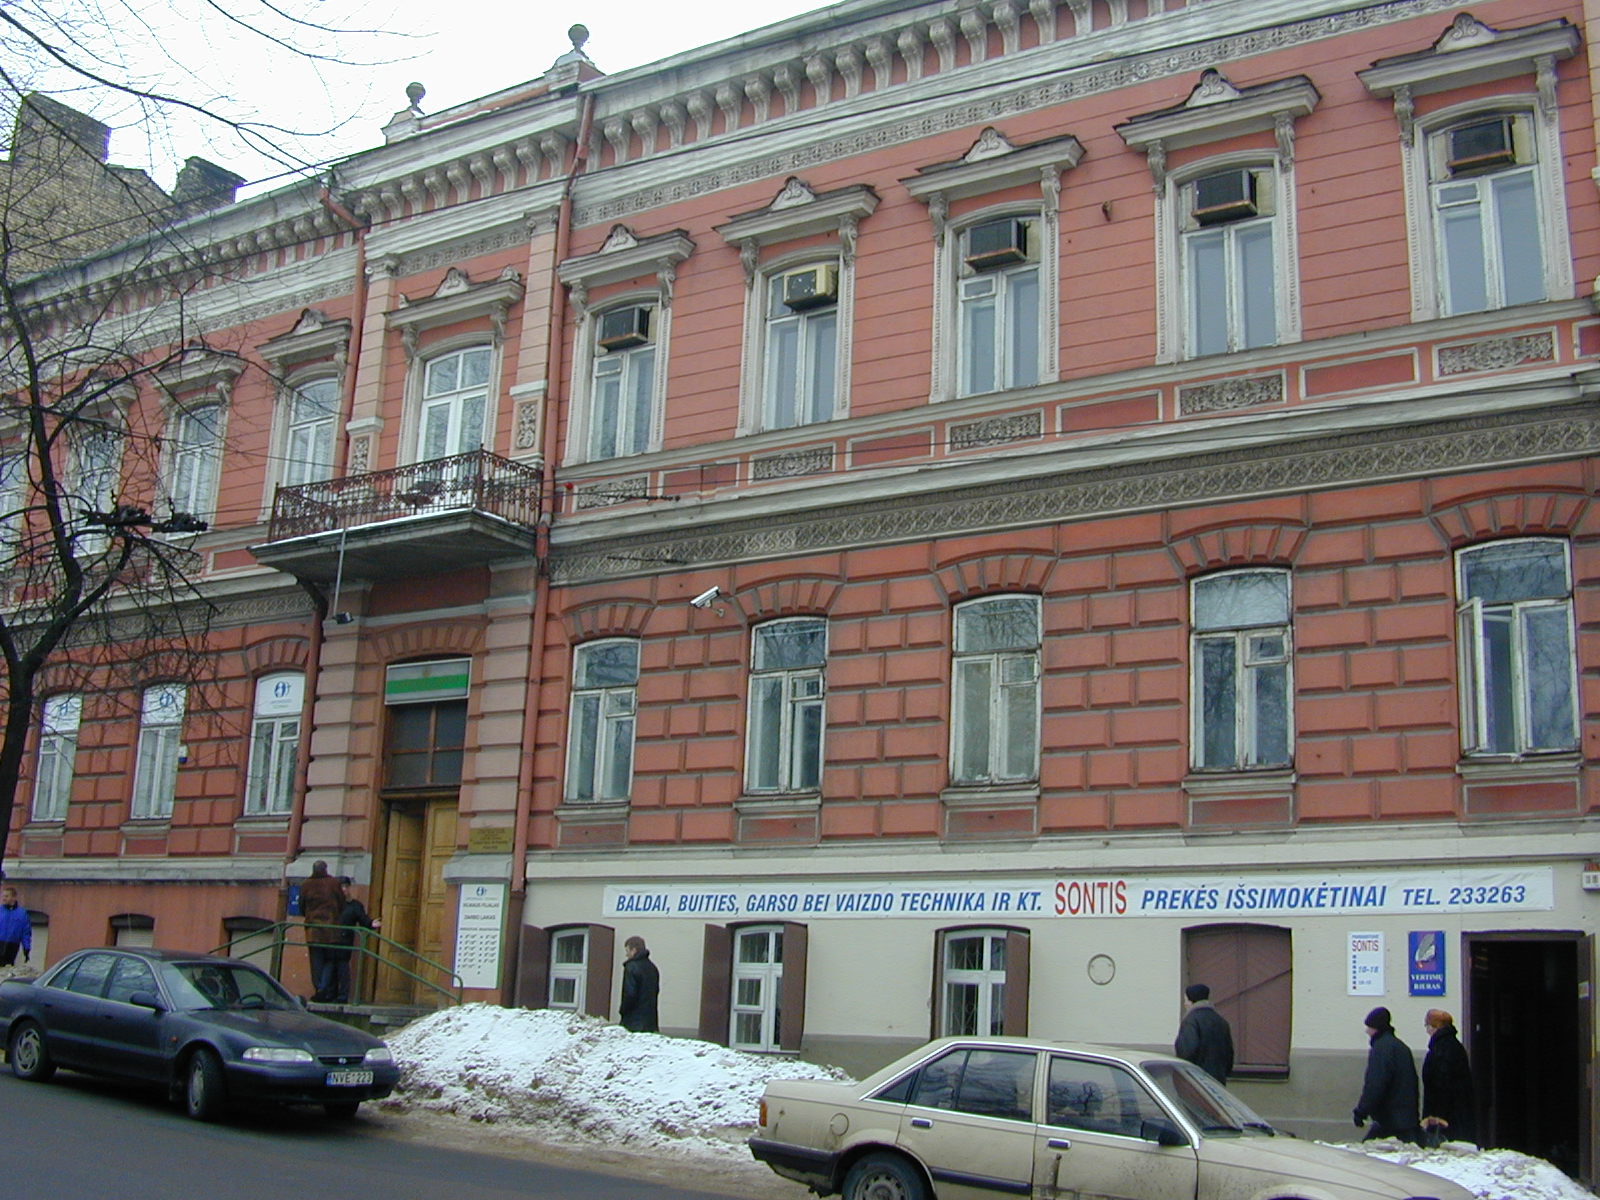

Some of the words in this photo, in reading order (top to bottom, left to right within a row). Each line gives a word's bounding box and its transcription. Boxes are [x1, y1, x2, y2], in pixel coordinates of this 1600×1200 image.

[616, 895, 671, 914] BALDAI,
[678, 894, 740, 914] BUITIES,
[746, 894, 798, 912] GARSO
[802, 894, 831, 912] BEI
[835, 893, 894, 912] VAIZDO
[900, 892, 986, 911] TECHNIKA
[991, 892, 1011, 911] IR
[1016, 892, 1042, 911] KT.
[1054, 880, 1127, 915] SONTIS
[1141, 885, 1219, 910] PREKĖS
[1225, 882, 1387, 910] IŠSIMOKĖTINAI
[1402, 888, 1441, 906] TEL.
[1448, 885, 1526, 905] 233263
[1352, 940, 1379, 951] SONTIS
